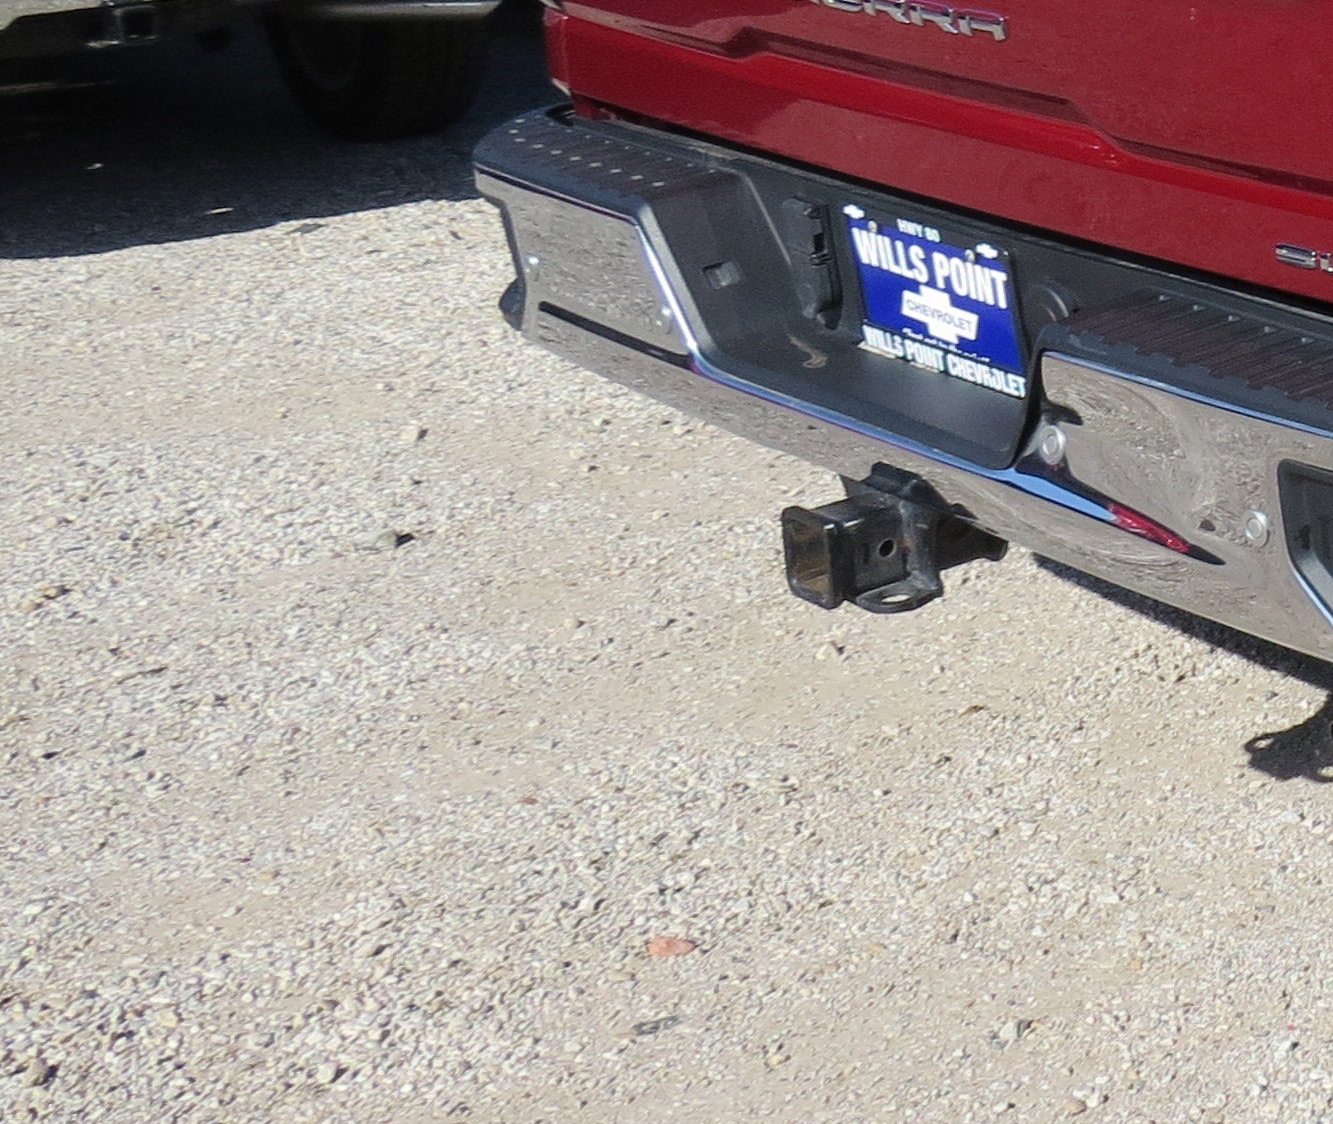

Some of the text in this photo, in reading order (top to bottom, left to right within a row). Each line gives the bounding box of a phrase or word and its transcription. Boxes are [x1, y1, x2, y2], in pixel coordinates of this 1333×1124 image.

[897, 218, 923, 238] HWY
[851, 227, 1008, 309] WILLS POINT
[906, 298, 973, 329] CHEVROLET
[862, 324, 903, 357] WILLS
[905, 337, 945, 371] POINT
[947, 352, 1027, 398] CHEVROLET
